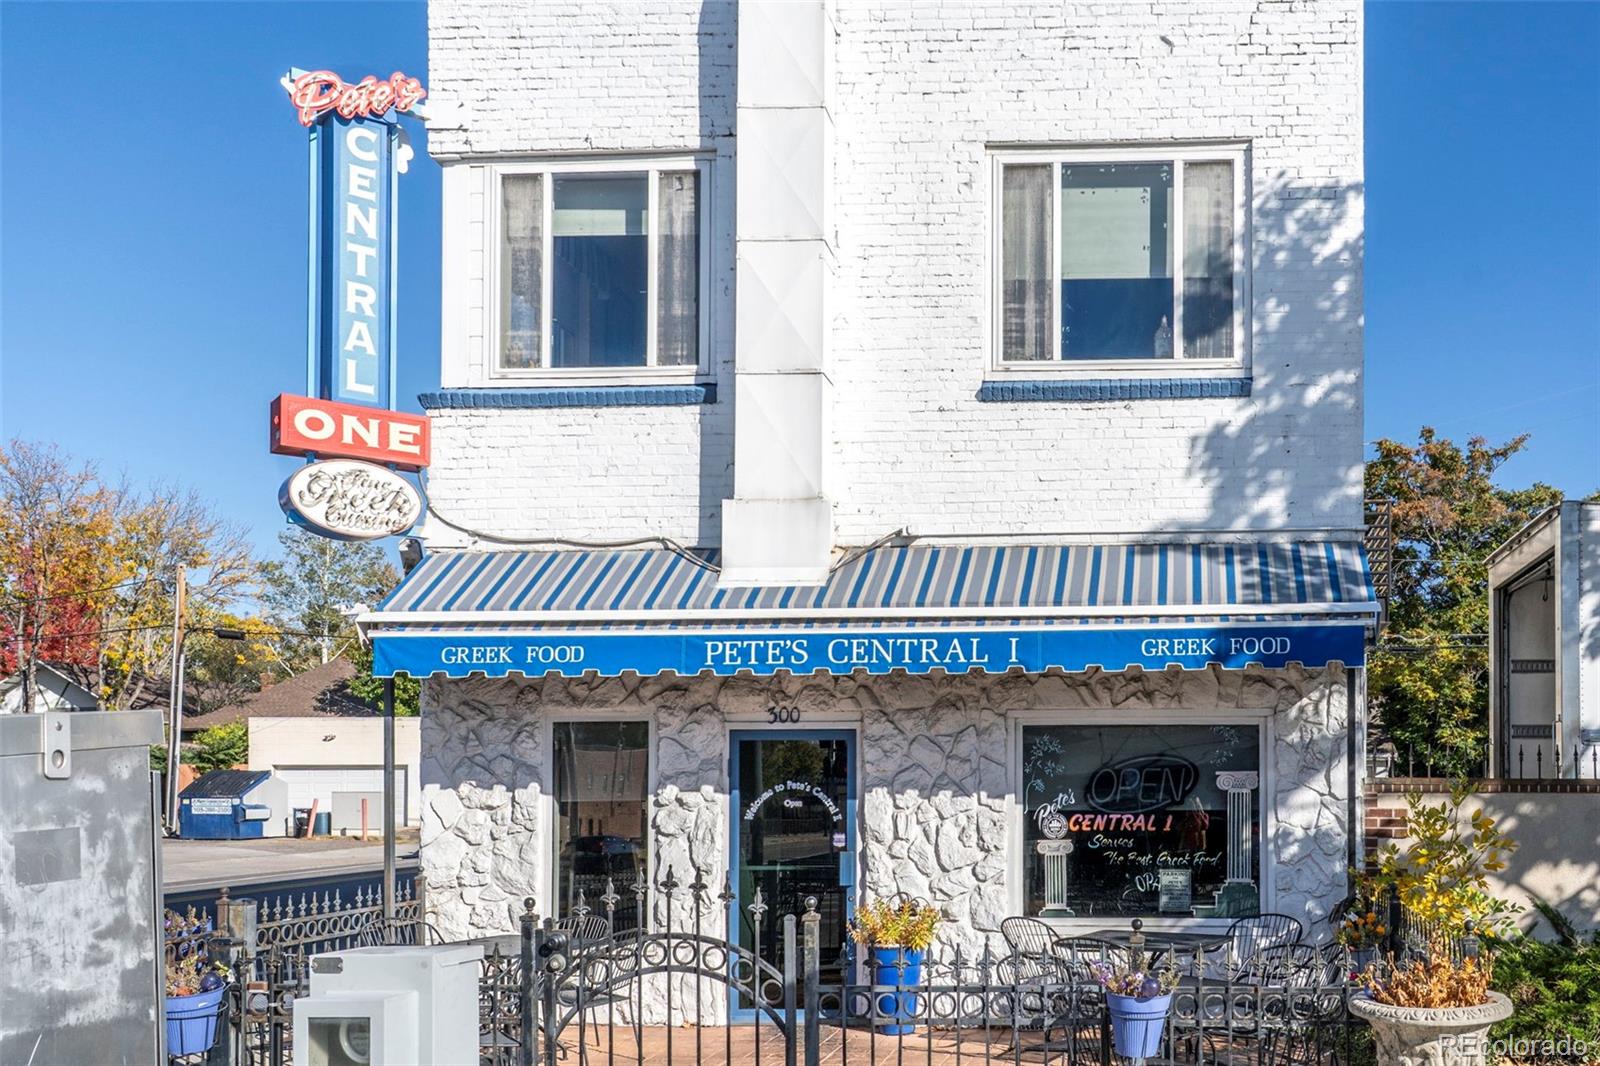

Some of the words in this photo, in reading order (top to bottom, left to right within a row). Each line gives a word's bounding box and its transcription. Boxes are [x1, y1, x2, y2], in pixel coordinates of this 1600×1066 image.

[292, 71, 427, 127] Pete's
[344, 127, 378, 395] CENTRAL
[294, 408, 421, 455] ONE
[441, 646, 513, 664] GREEK
[526, 645, 585, 663] FOOD
[704, 640, 808, 666] PETE'S
[827, 638, 988, 664] CENTRAL
[1009, 638, 1019, 662] I
[1141, 638, 1216, 656] GREEK
[1229, 637, 1290, 655] FOOD
[767, 706, 800, 724] 300
[744, 788, 774, 821] Welcome
[774, 783, 785, 793] to
[786, 780, 811, 792] Pete's
[812, 787, 839, 815] Central
[1091, 767, 1184, 803] OPEN
[783, 799, 803, 809] Open
[1033, 788, 1076, 831] Pete's
[1069, 814, 1156, 832] CENTRAL
